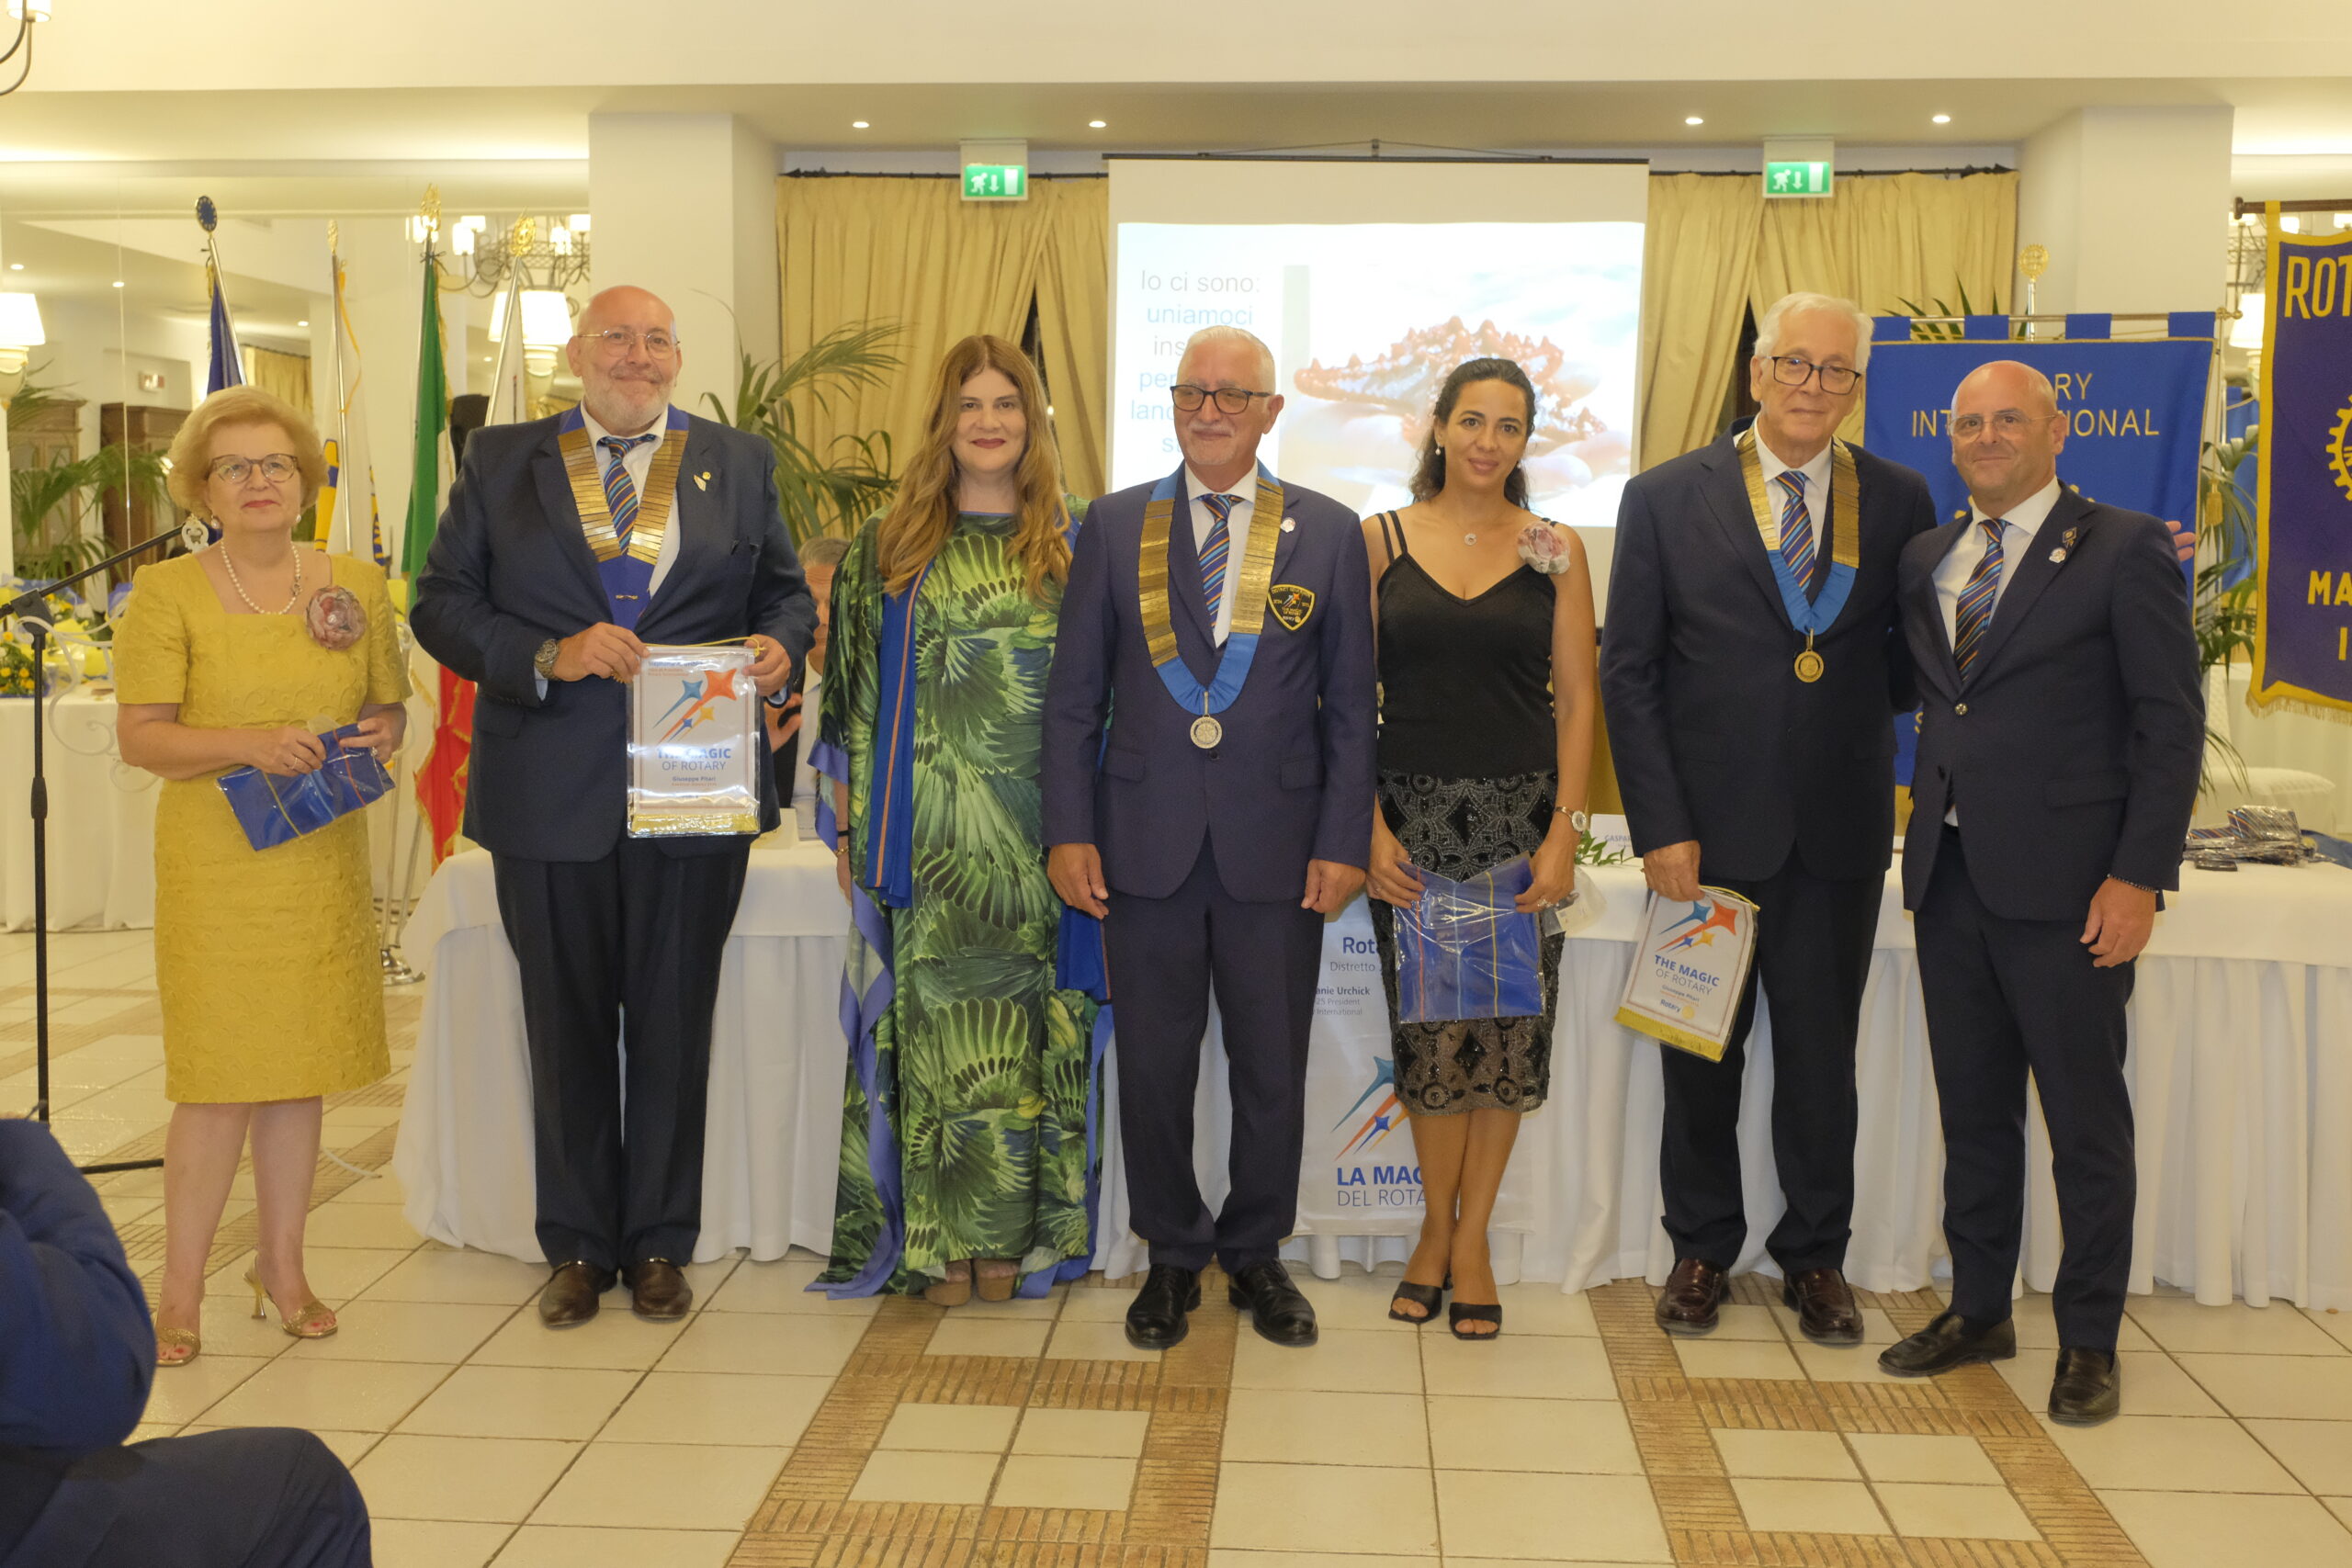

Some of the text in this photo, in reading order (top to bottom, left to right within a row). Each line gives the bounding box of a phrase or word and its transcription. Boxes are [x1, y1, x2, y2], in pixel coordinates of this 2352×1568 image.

[1170, 271, 1188, 292] ci
[1148, 303, 1252, 325] uniamoci
[1154, 334, 1186, 356] ins
[2054, 372, 2093, 400] RY
[662, 761, 726, 772] OF ROTARY
[1342, 936, 1376, 954] Rot
[1329, 961, 1375, 972] Distretto
[1655, 954, 1720, 987] THE MAGIC
[1316, 986, 1371, 996] anie Urchick
[1656, 968, 1713, 996] OF ROTARY
[1337, 1167, 1367, 1186] LA
[1337, 1189, 1426, 1207] DEL ROTA
